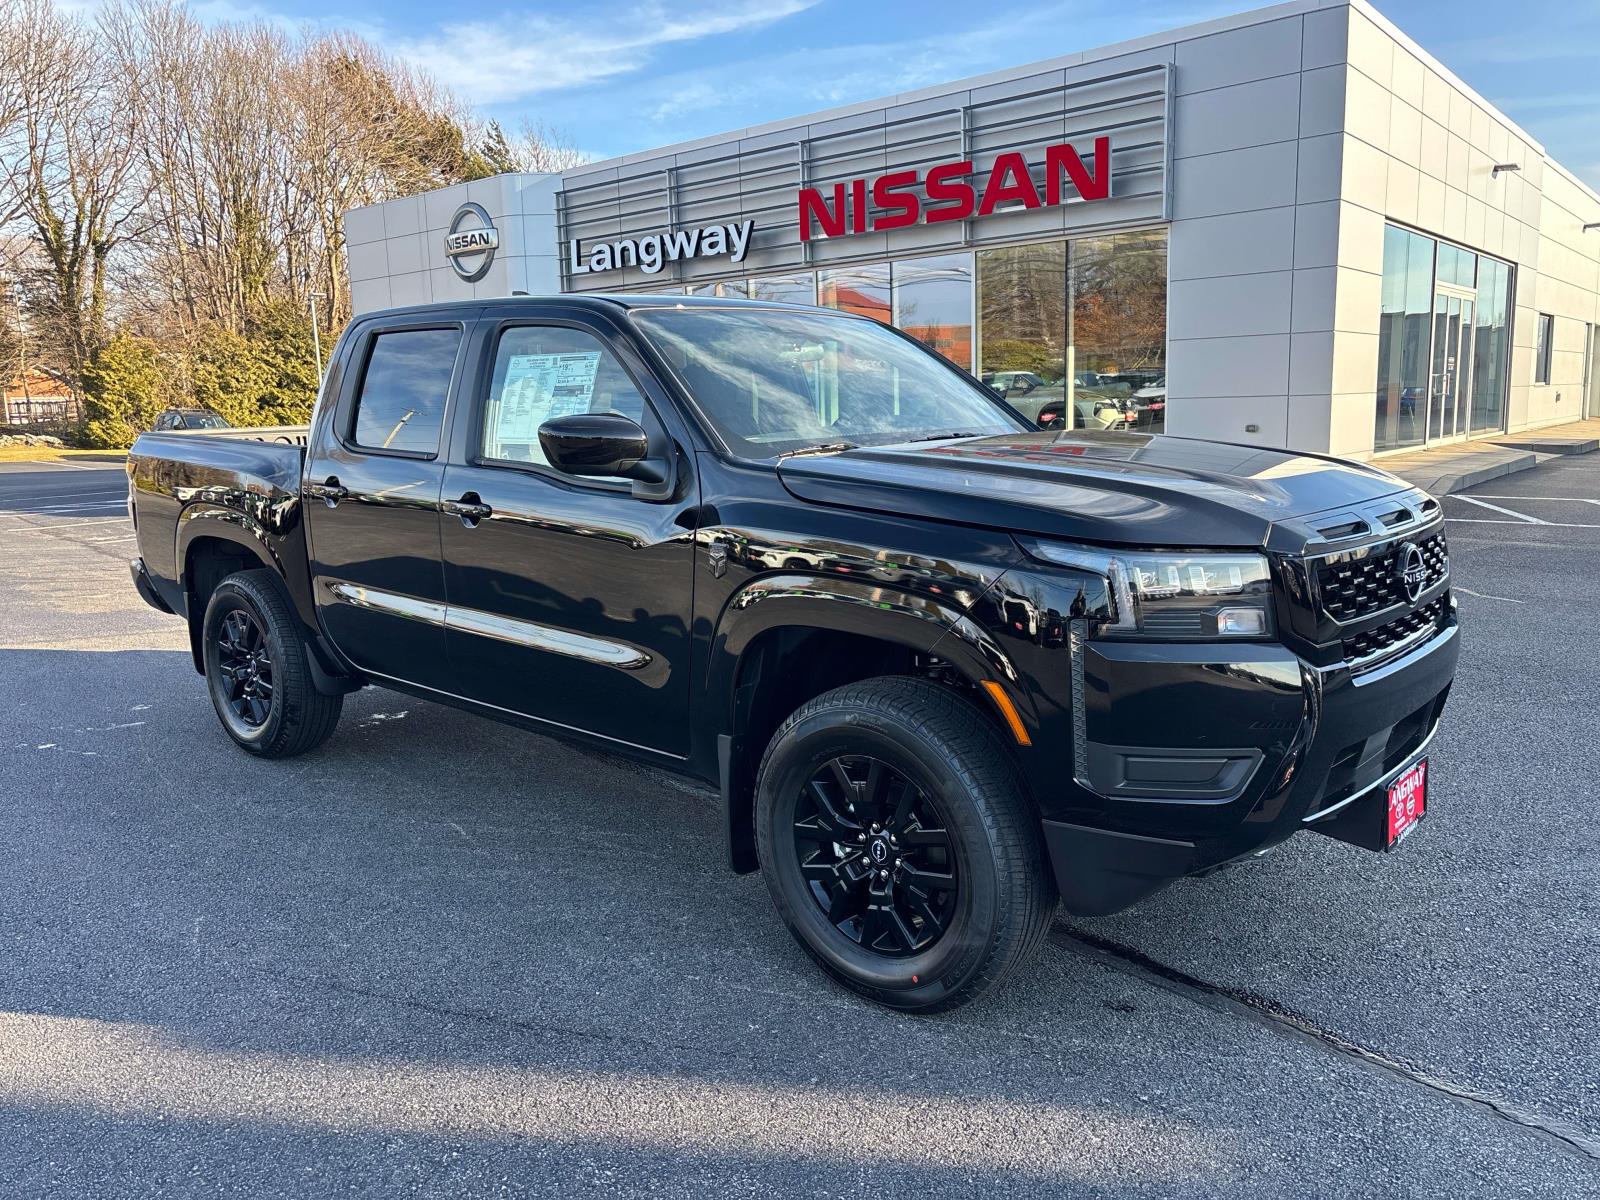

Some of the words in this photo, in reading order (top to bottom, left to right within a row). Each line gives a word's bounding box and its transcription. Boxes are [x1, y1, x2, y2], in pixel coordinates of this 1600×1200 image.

[798, 136, 1110, 241] NISSAN
[446, 232, 490, 250] NISSAN
[570, 220, 753, 274] Langway
[1404, 571, 1426, 583] NISS
